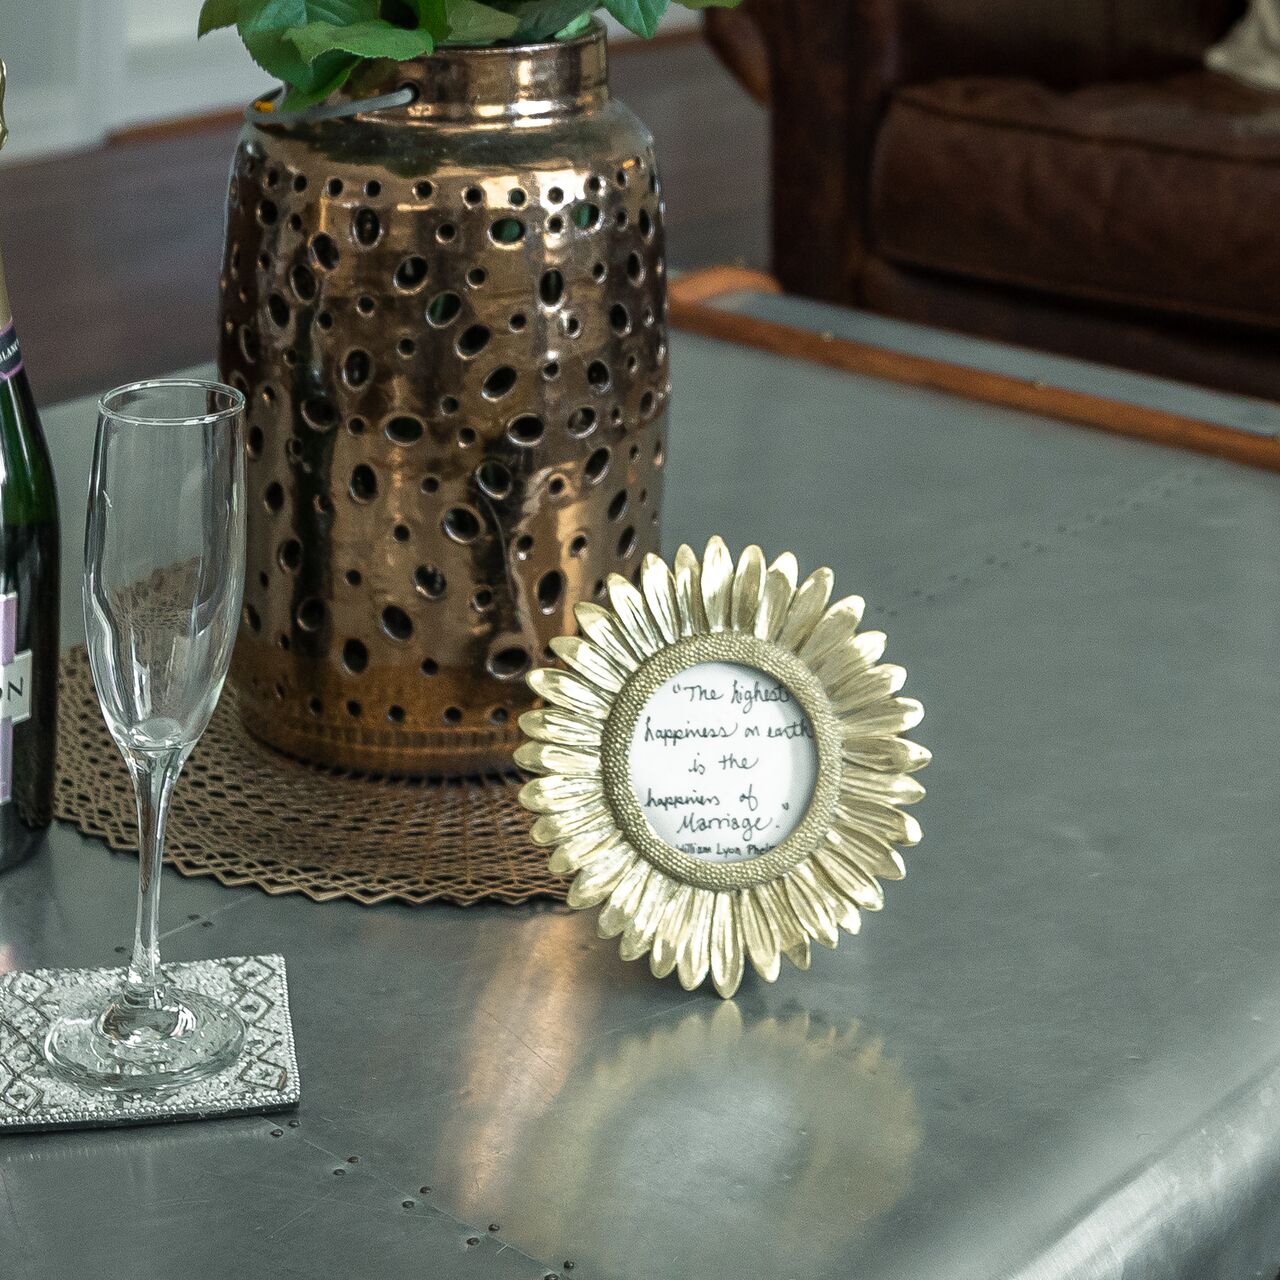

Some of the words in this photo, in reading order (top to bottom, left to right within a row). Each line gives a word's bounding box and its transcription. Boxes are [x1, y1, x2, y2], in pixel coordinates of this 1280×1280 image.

[730, 680, 790, 714] highest
[644, 716, 739, 747] happiness
[744, 725, 760, 738] on
[767, 718, 814, 740] earth
[688, 752, 707, 775] is
[718, 753, 760, 770] the
[739, 783, 759, 812] of
[716, 842, 742, 859] Lyon
